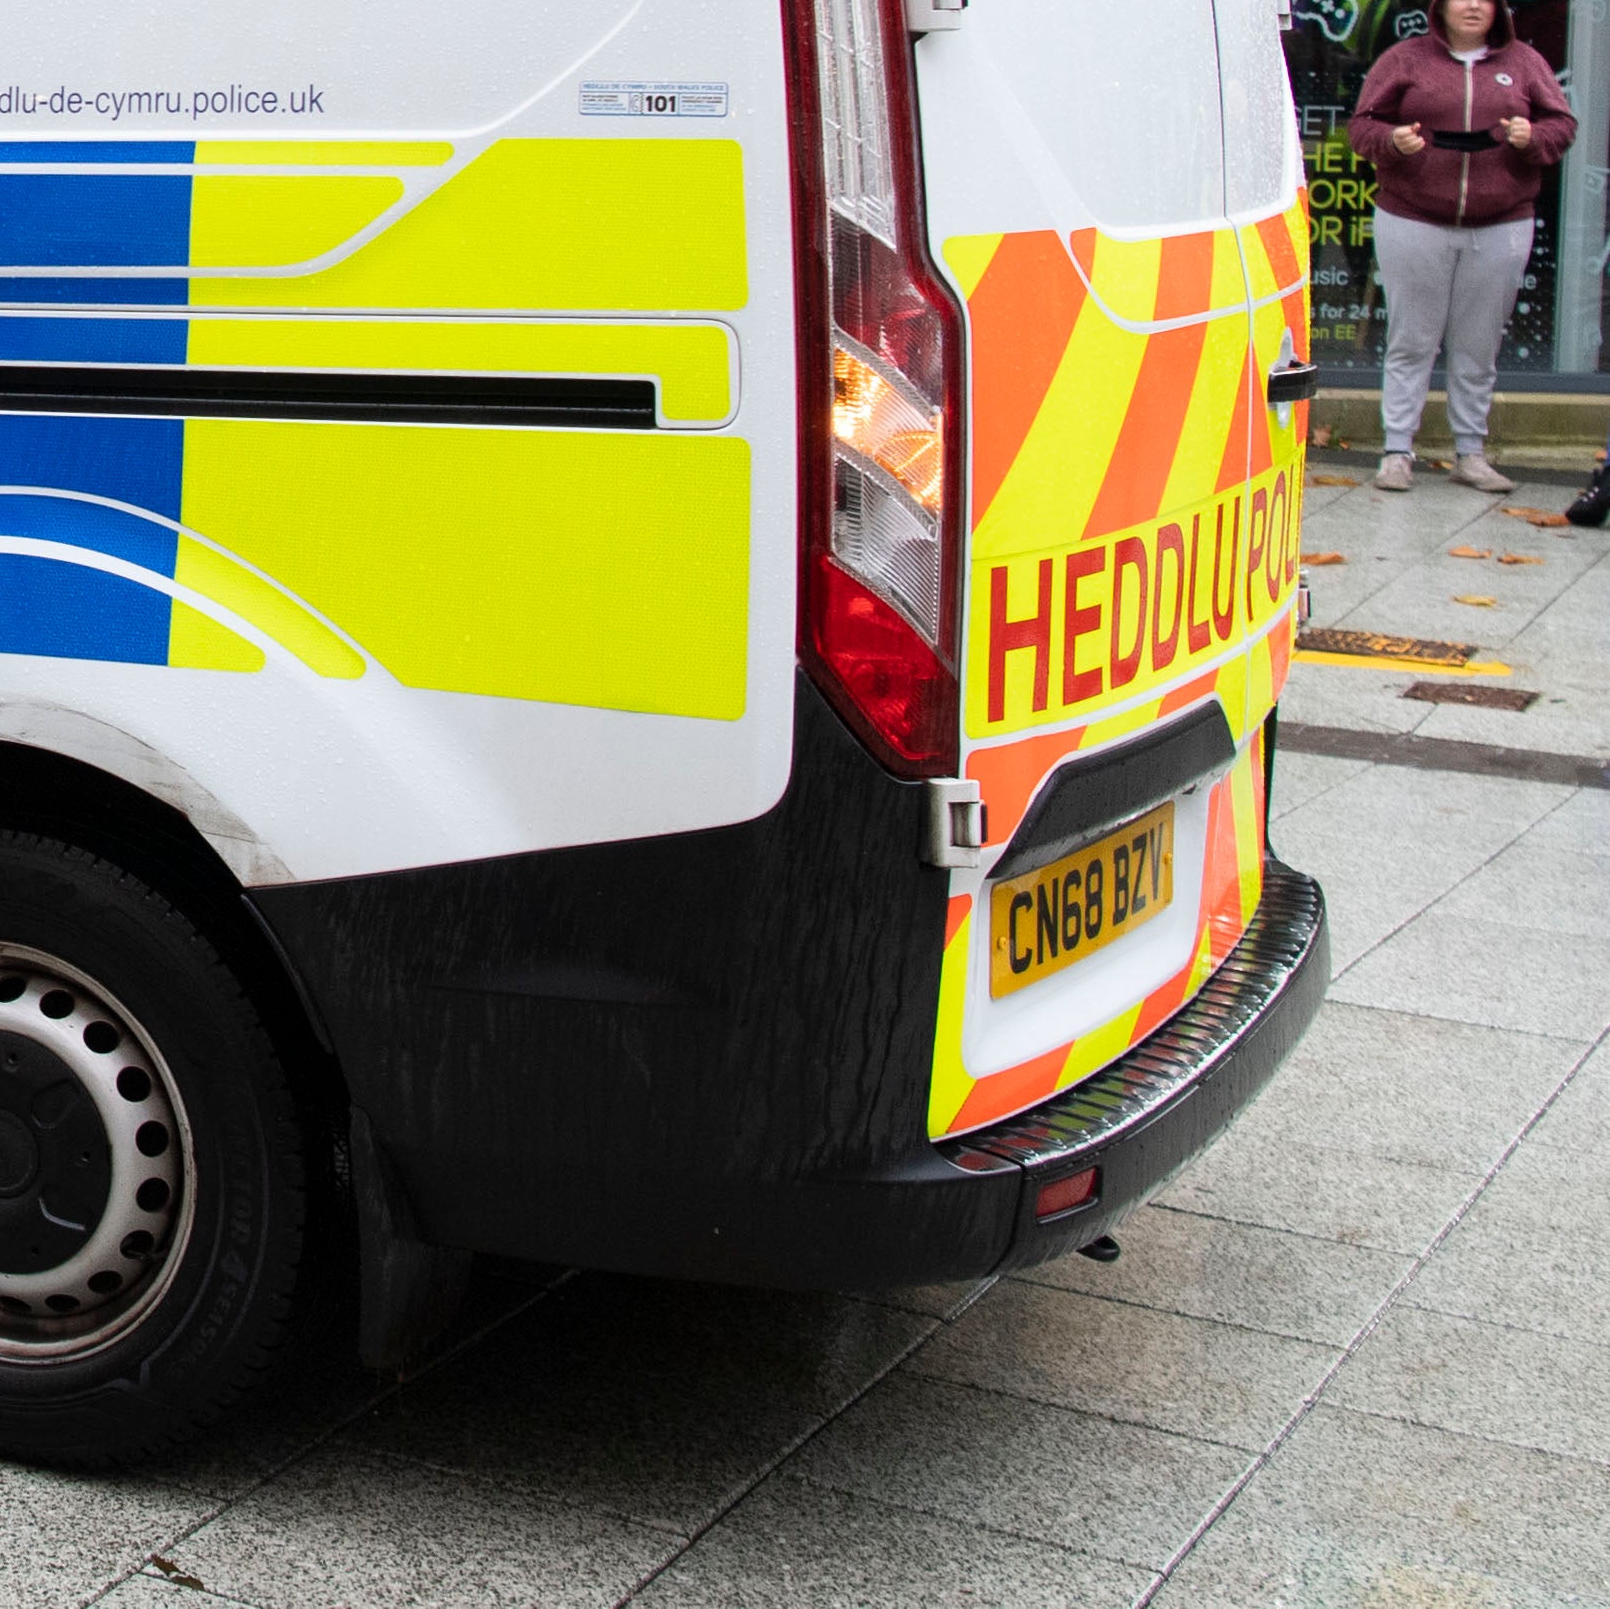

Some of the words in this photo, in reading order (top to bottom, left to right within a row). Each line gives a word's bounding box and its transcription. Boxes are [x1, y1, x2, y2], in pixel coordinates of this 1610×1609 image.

[645, 95, 676, 112] 101
[1309, 179, 1379, 210] ORK
[1334, 324, 1357, 340] EE
[988, 497, 1240, 723] HEDDLU
[1009, 858, 1103, 974] CN68
[1113, 822, 1164, 927] BZV
